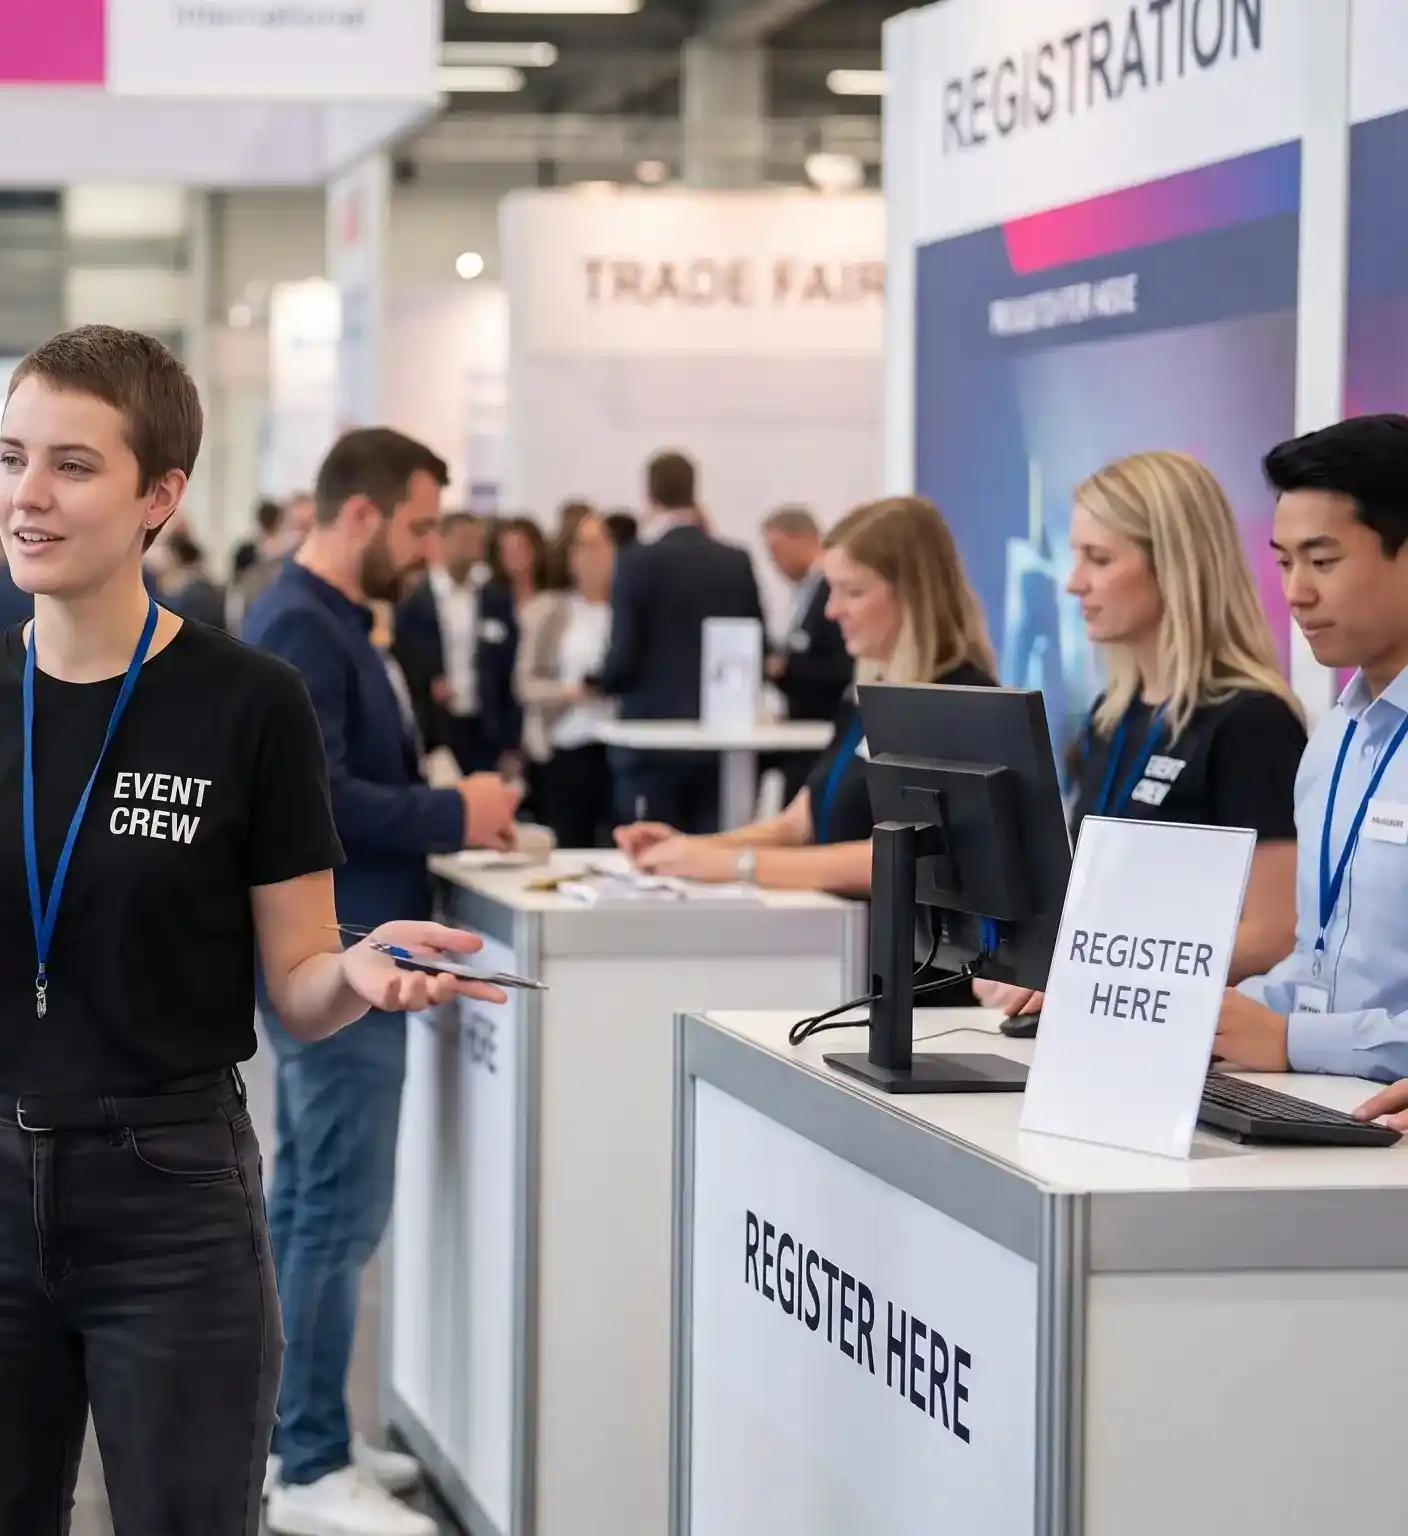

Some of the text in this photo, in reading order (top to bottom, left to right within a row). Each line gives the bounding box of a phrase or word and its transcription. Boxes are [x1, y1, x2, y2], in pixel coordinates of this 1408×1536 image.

[942, 0, 1263, 154] REGISTRATION
[584, 257, 753, 307] TRADE
[113, 771, 213, 808] EVENT
[109, 806, 201, 845] CREW
[1069, 929, 1213, 977] REGISTER
[1089, 982, 1171, 1024] HERE
[745, 1209, 972, 1445] REGISTER HERE
